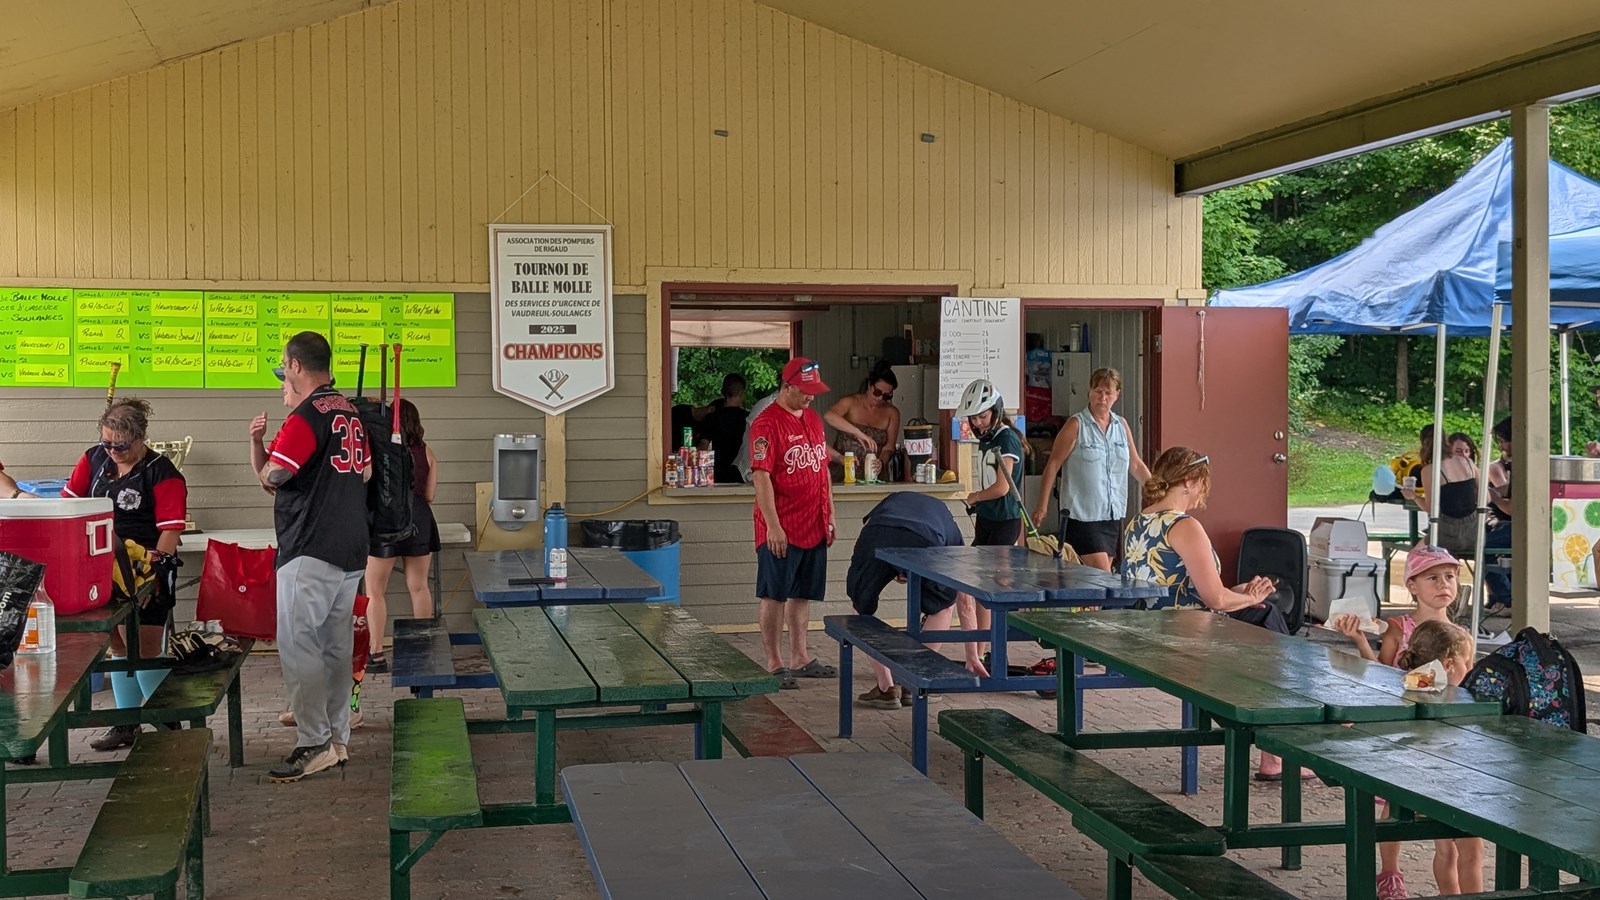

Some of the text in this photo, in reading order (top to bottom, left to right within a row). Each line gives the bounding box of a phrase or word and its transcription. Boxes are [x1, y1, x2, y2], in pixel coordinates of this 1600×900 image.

[514, 263, 589, 276] TOURNOI DE
[511, 281, 592, 293] BALLE MOLLE
[41, 293, 68, 301] MOLLE
[115, 301, 125, 313] 2
[137, 304, 150, 312] VS
[191, 301, 199, 312] 4
[243, 304, 255, 315] 13
[944, 299, 1008, 317] CANTINE
[115, 328, 126, 340] 2
[540, 325, 565, 334] 2025
[55, 341, 65, 350] 10
[503, 343, 604, 360] CHAMPIONS
[140, 356, 151, 364] VS
[247, 357, 255, 370] 4
[58, 367, 65, 378] 8
[330, 414, 365, 475] 36
[904, 439, 932, 454] DONS
